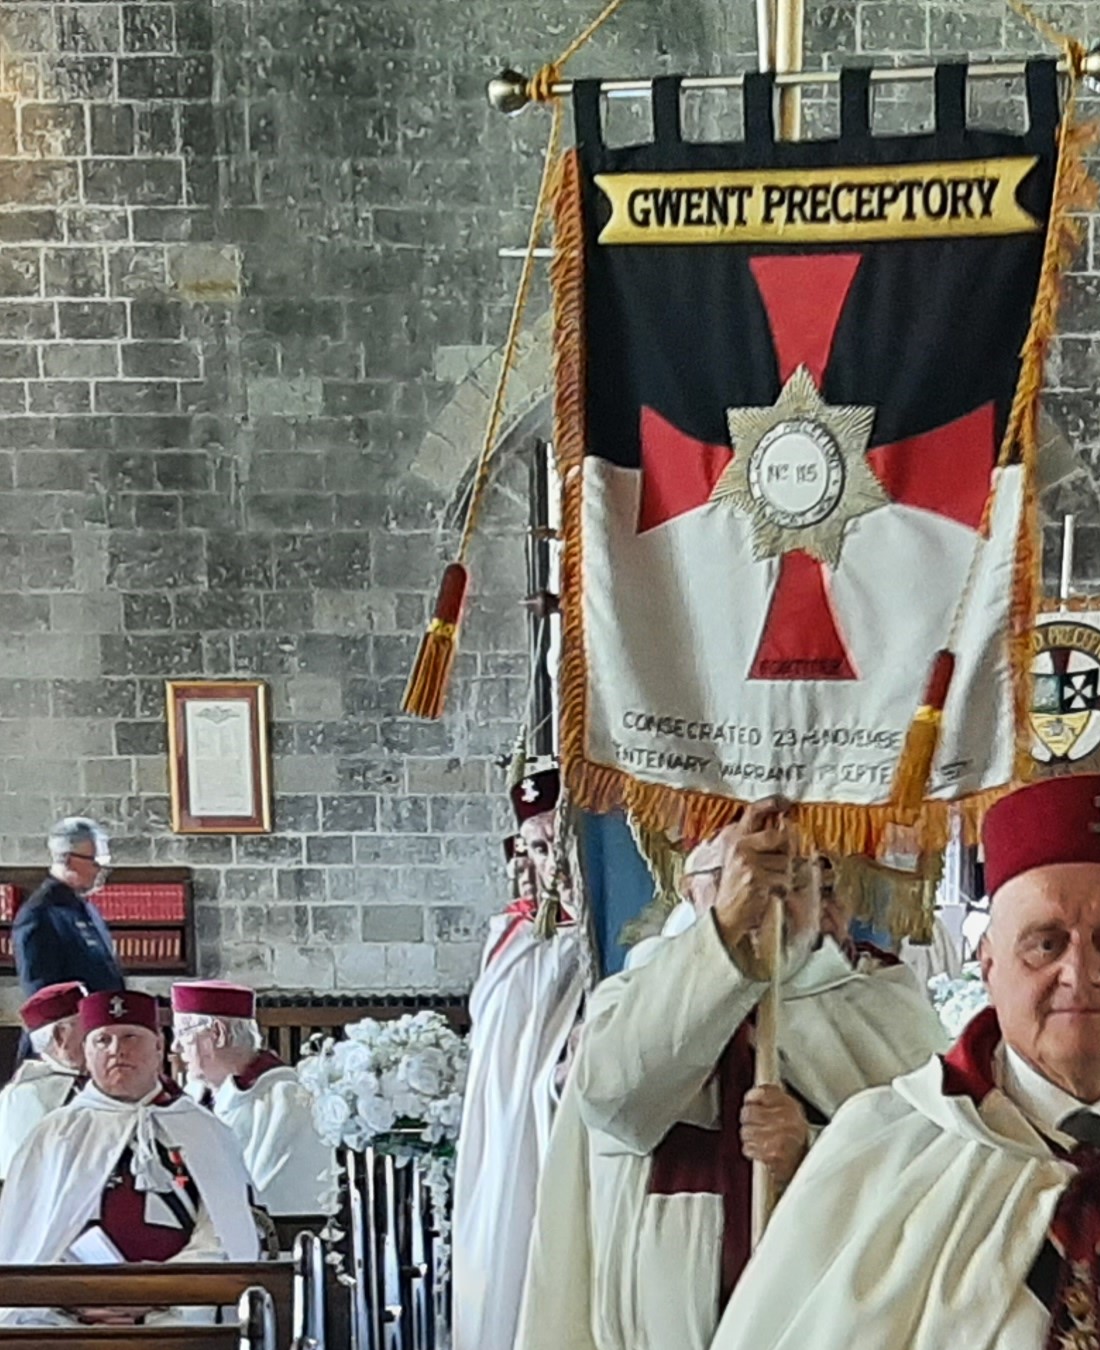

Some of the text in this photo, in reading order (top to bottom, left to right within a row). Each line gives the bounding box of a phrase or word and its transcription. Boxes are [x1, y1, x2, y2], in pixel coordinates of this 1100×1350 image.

[628, 176, 1000, 228] GWENT PRECEPTORY
[622, 710, 762, 746] CONSECRATED
